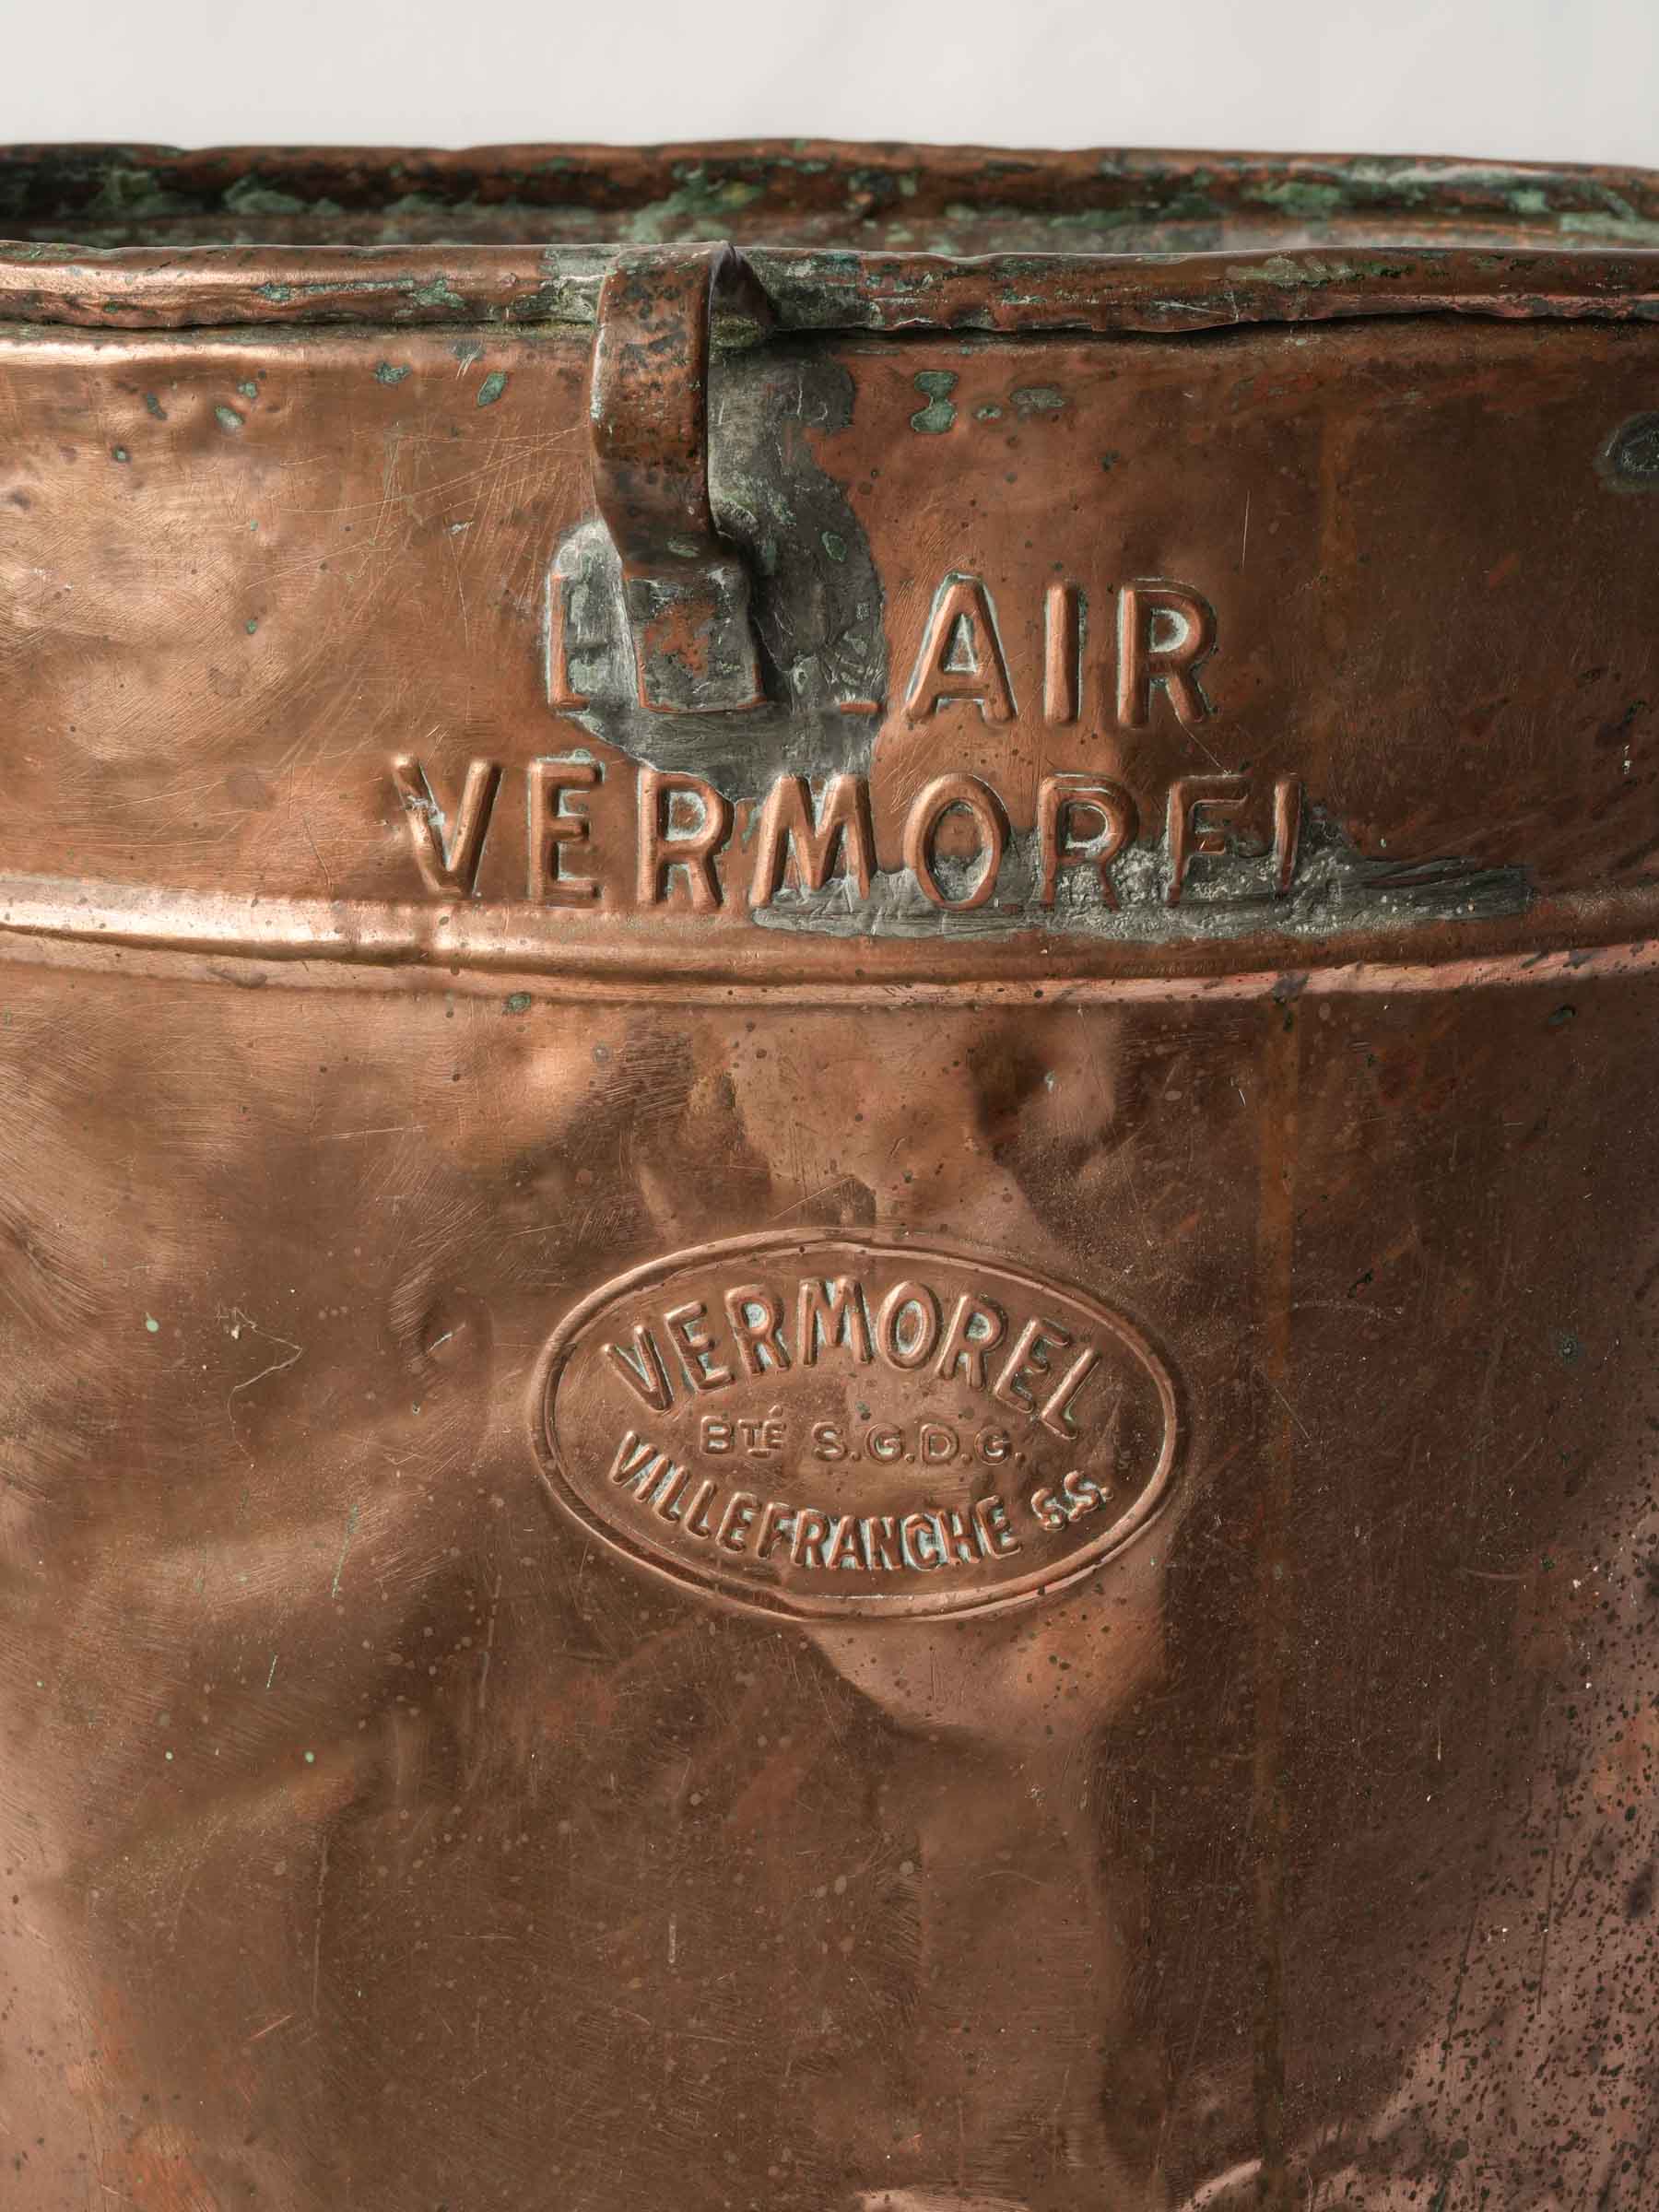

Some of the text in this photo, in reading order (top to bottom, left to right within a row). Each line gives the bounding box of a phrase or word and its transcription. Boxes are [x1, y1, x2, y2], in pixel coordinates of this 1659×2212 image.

[602, 1275, 1101, 1440] VERMOREL
[607, 1430, 1022, 1571] VILLEFRANCHE
[810, 1420, 1026, 1466] S.G.D.G.
